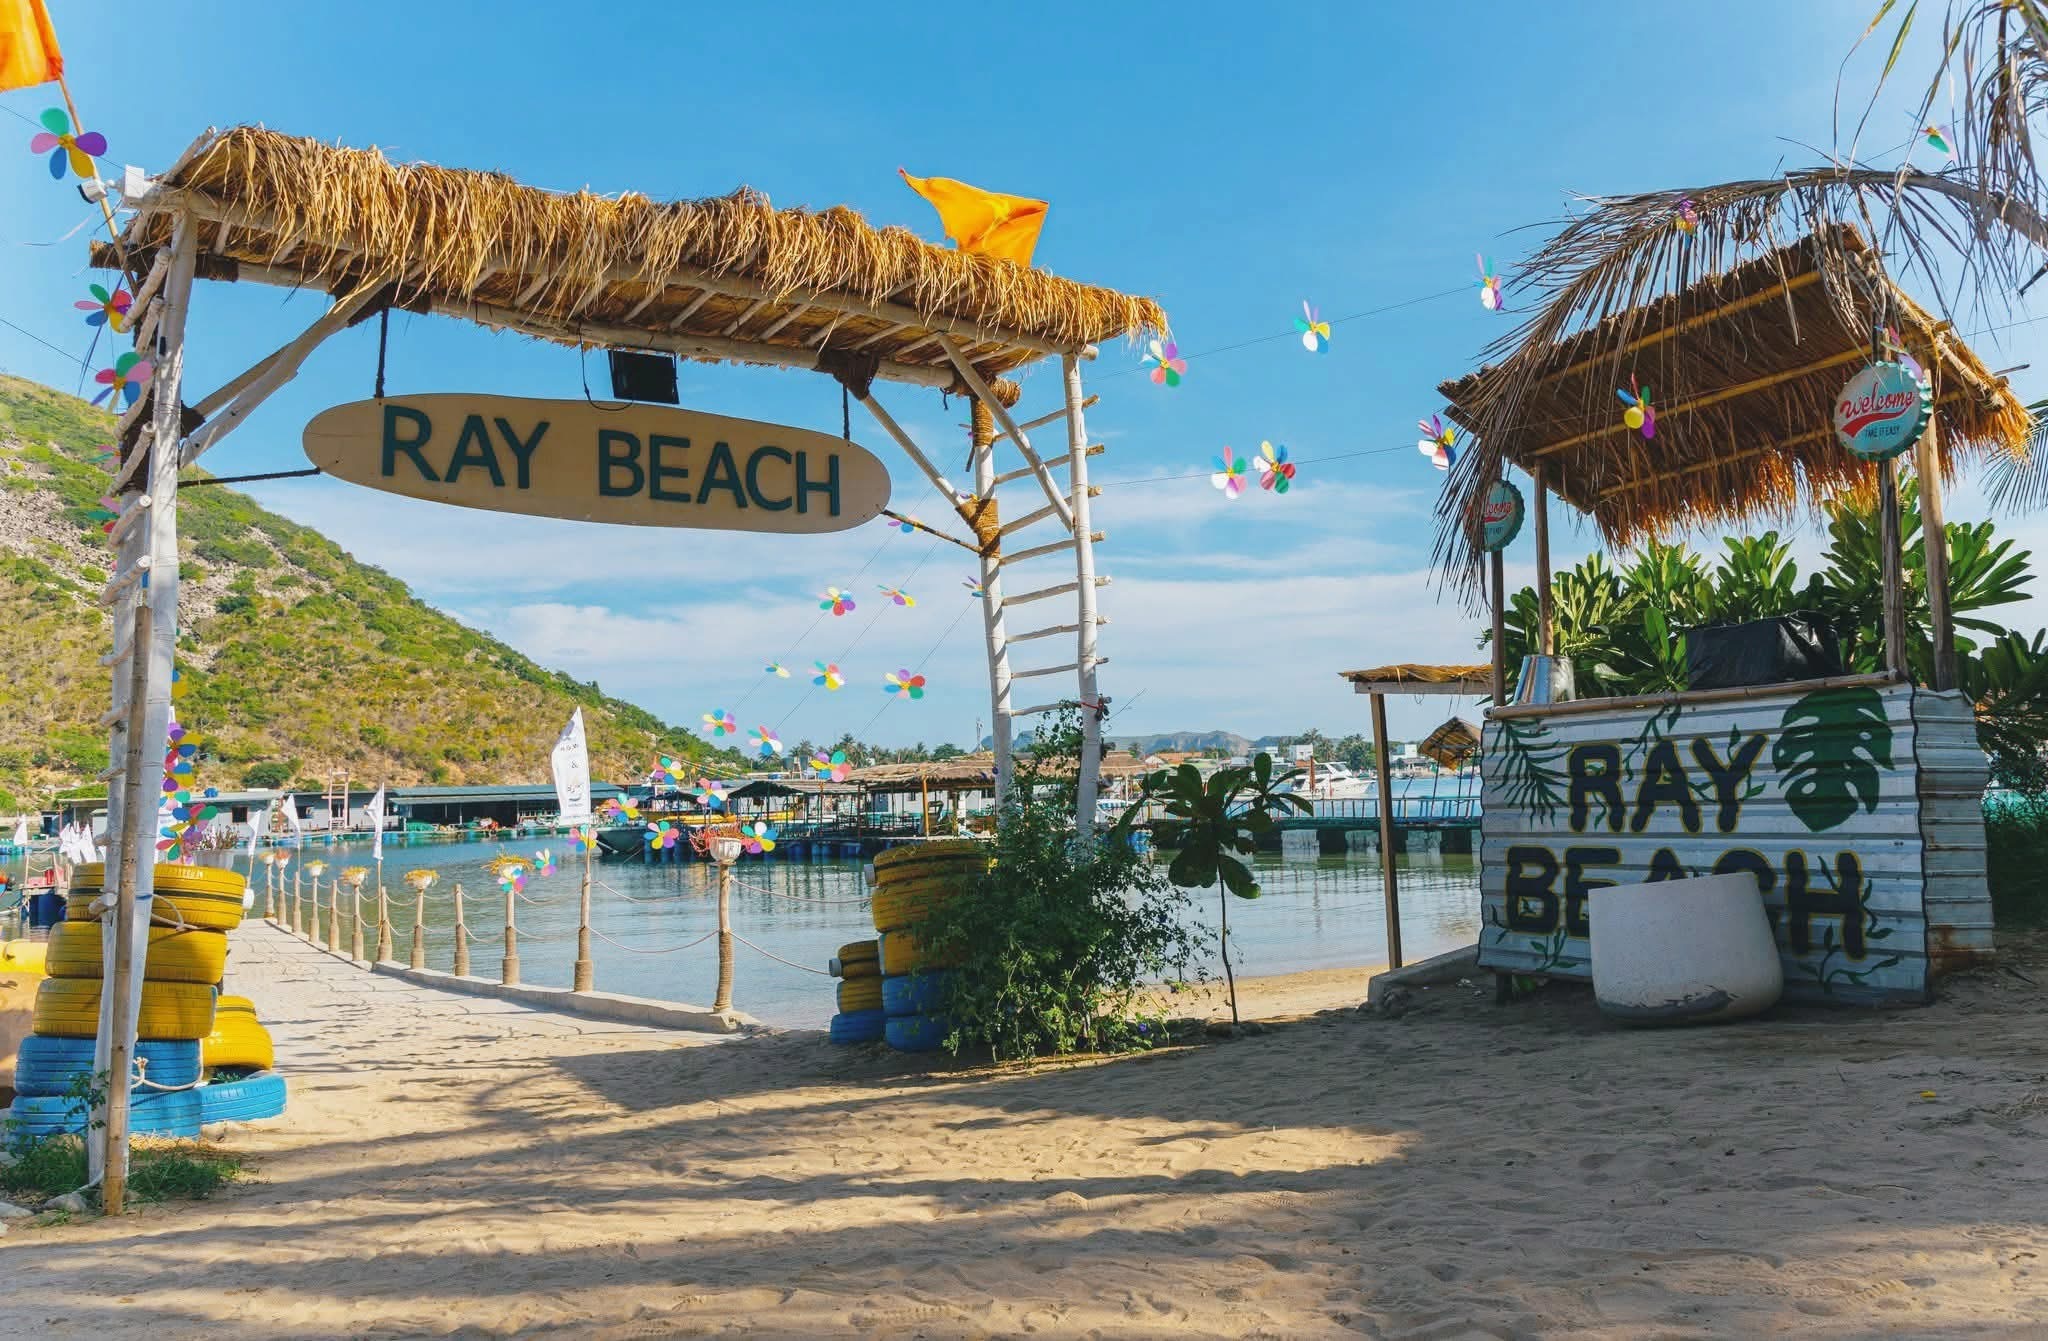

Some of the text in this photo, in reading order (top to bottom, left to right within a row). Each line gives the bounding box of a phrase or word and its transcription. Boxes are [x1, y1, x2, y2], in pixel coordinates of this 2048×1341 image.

[1840, 382, 1914, 418] Welcome
[381, 404, 841, 517] RAY BEACH
[1567, 733, 1770, 834] RAY
